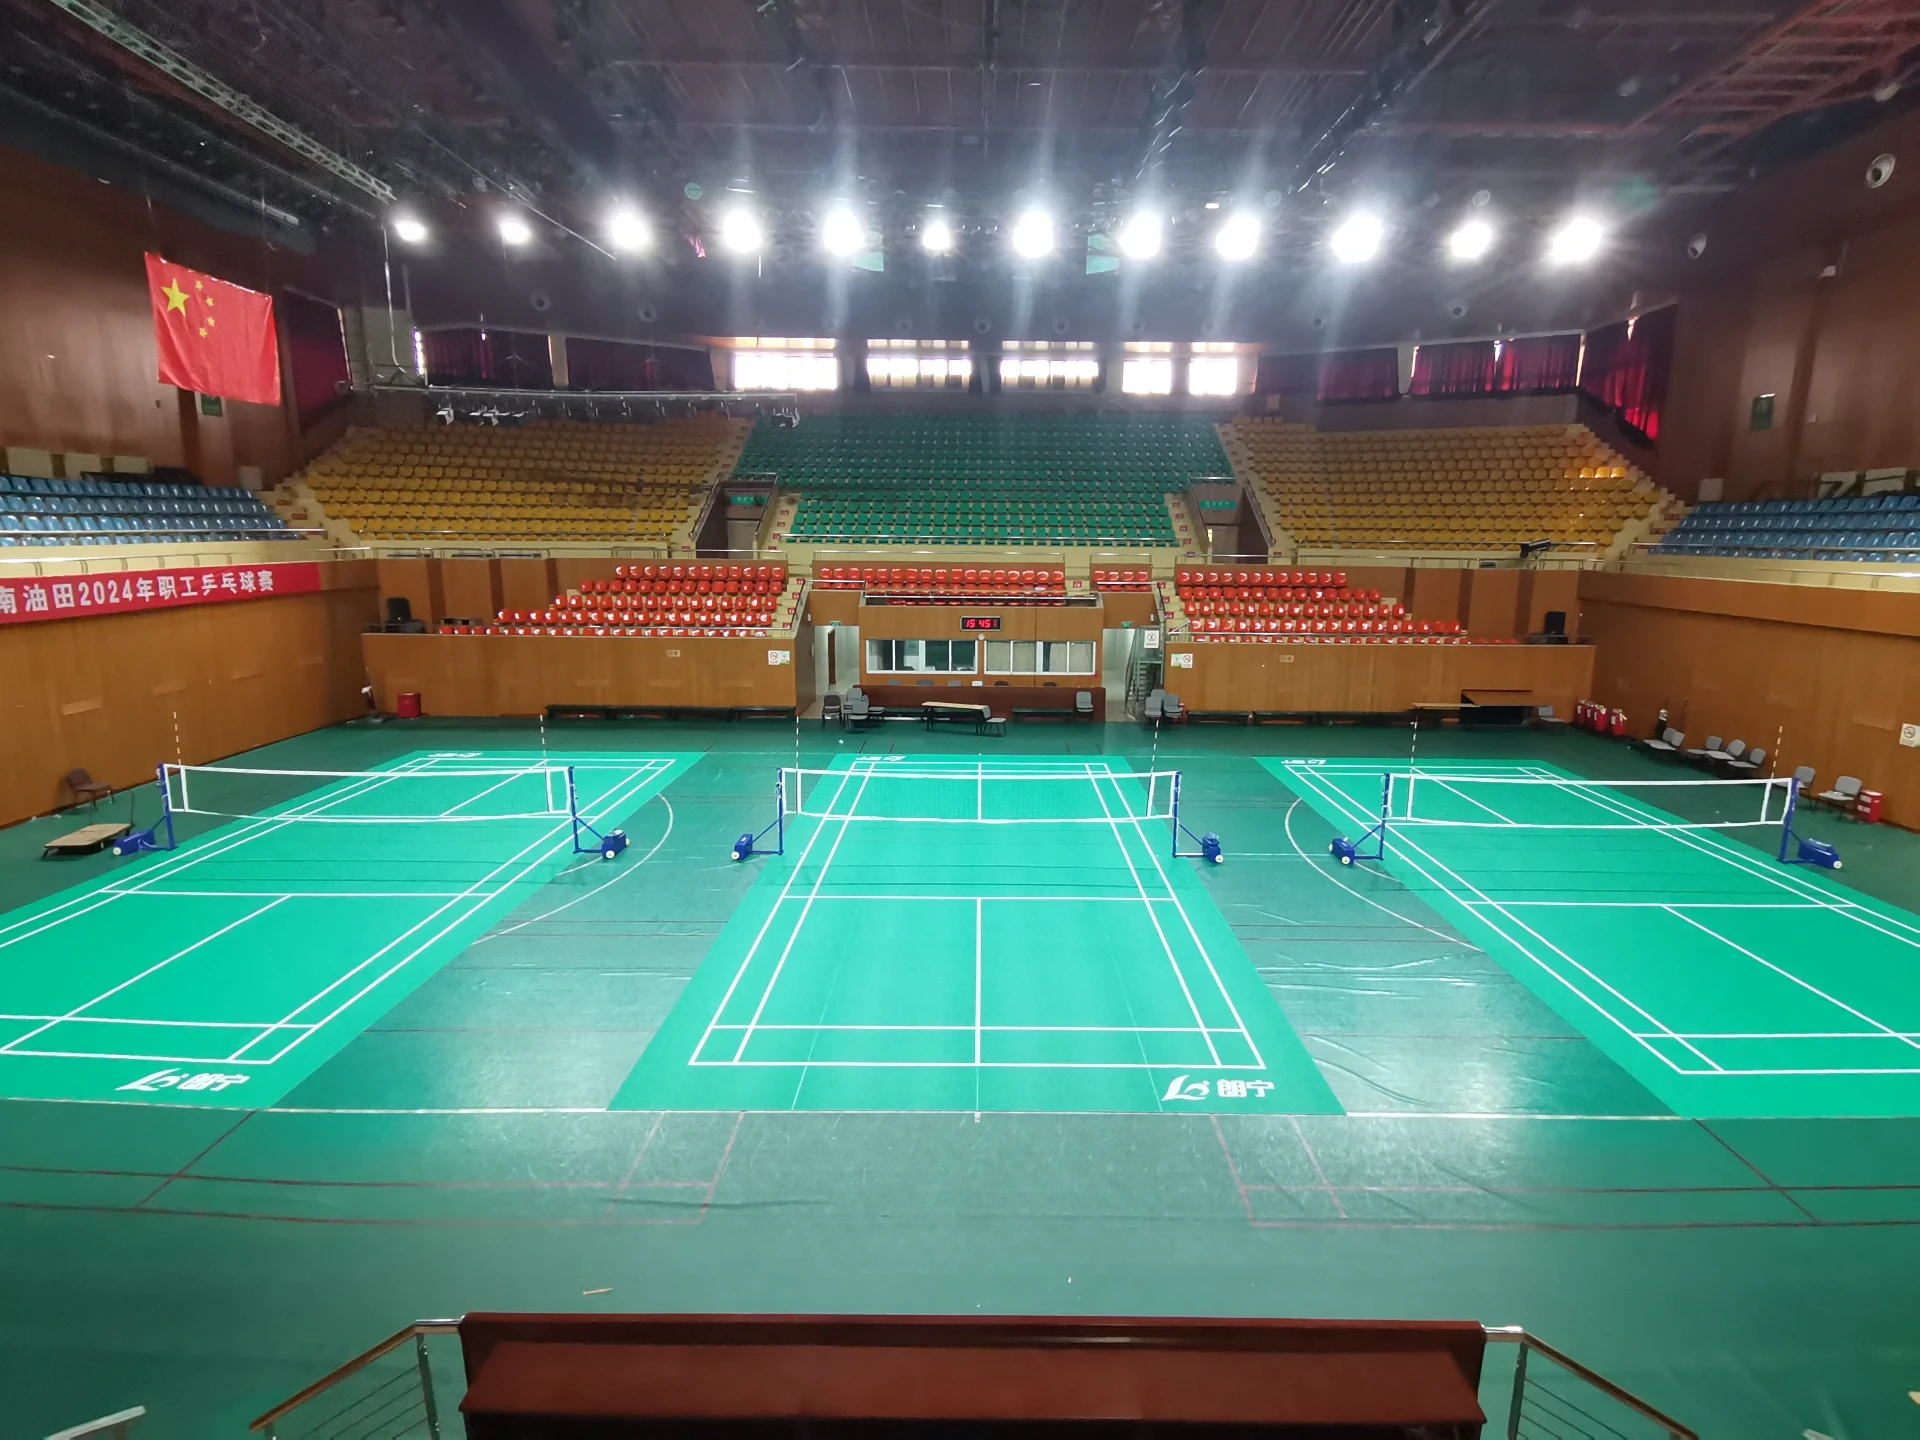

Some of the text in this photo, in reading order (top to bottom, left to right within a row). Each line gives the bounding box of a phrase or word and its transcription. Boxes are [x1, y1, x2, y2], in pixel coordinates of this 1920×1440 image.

[0, 570, 274, 614] 南油田2024年职工乒乓球赛
